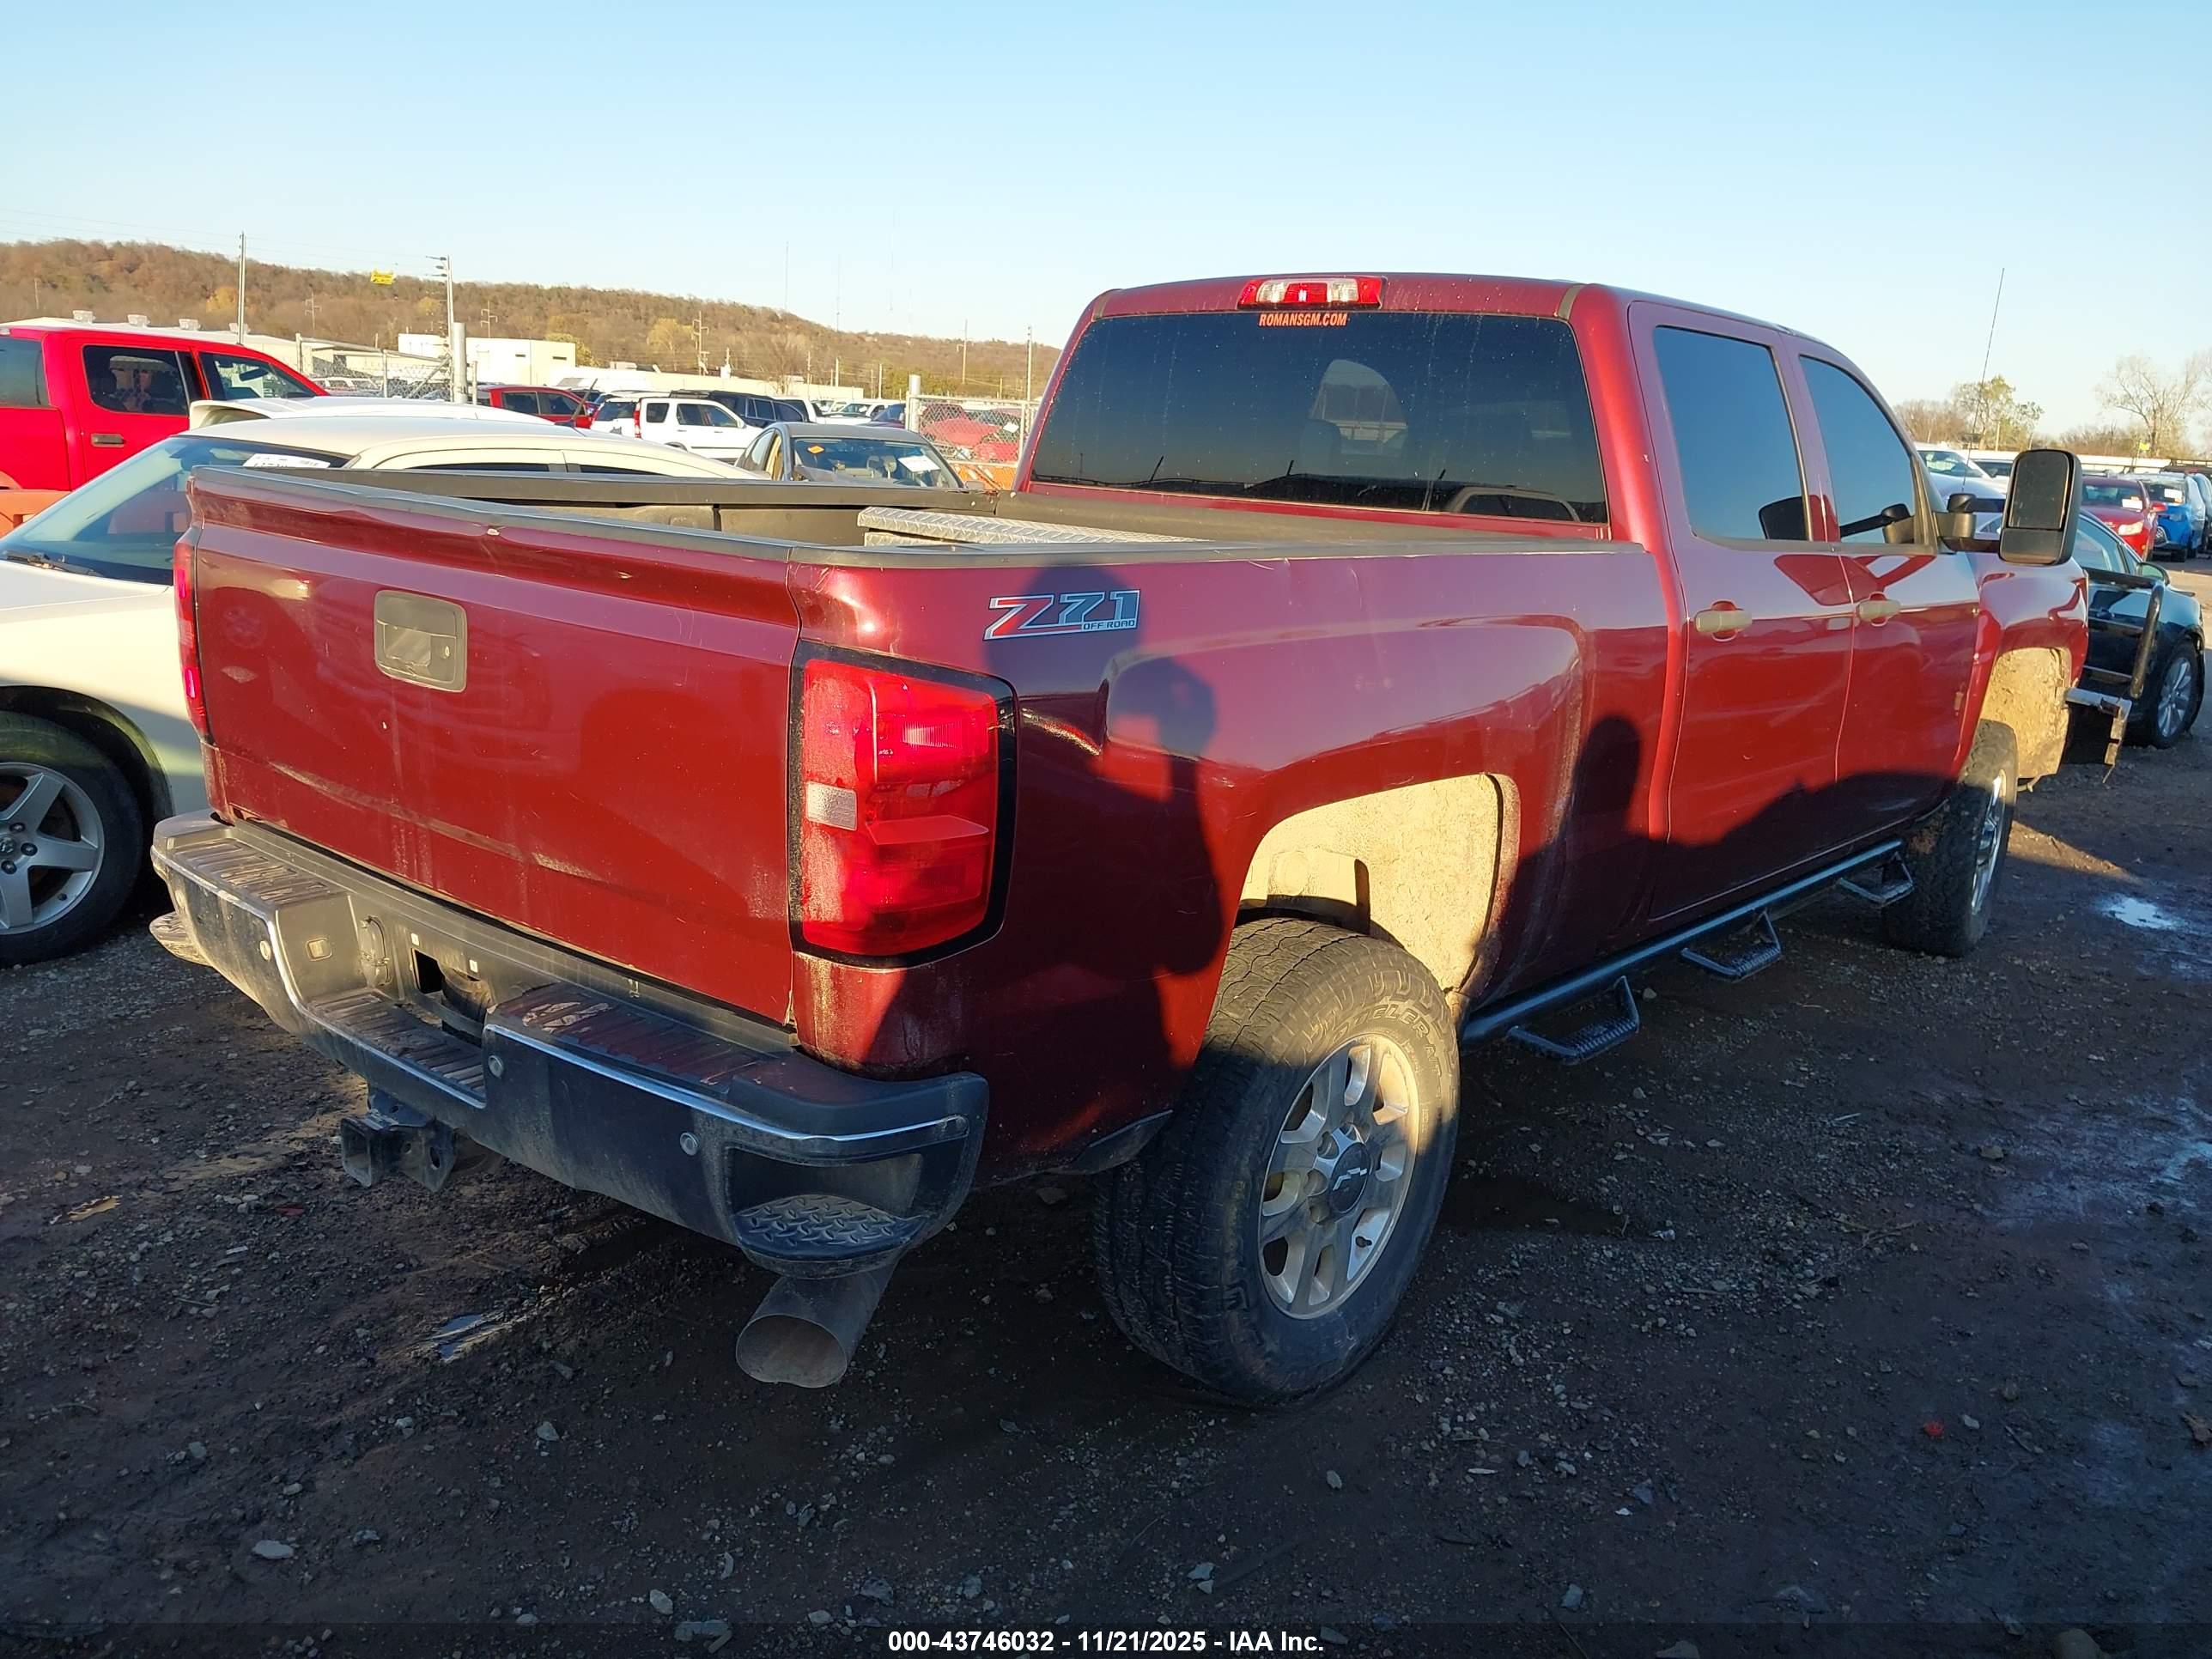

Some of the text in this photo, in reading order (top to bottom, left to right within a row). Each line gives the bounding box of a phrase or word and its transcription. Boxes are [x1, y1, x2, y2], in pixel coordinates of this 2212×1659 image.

[1258, 313, 1348, 327] ROMANSGM.COM
[983, 589, 1140, 641] Z71
[1083, 619, 1135, 631] OFF ROAD
